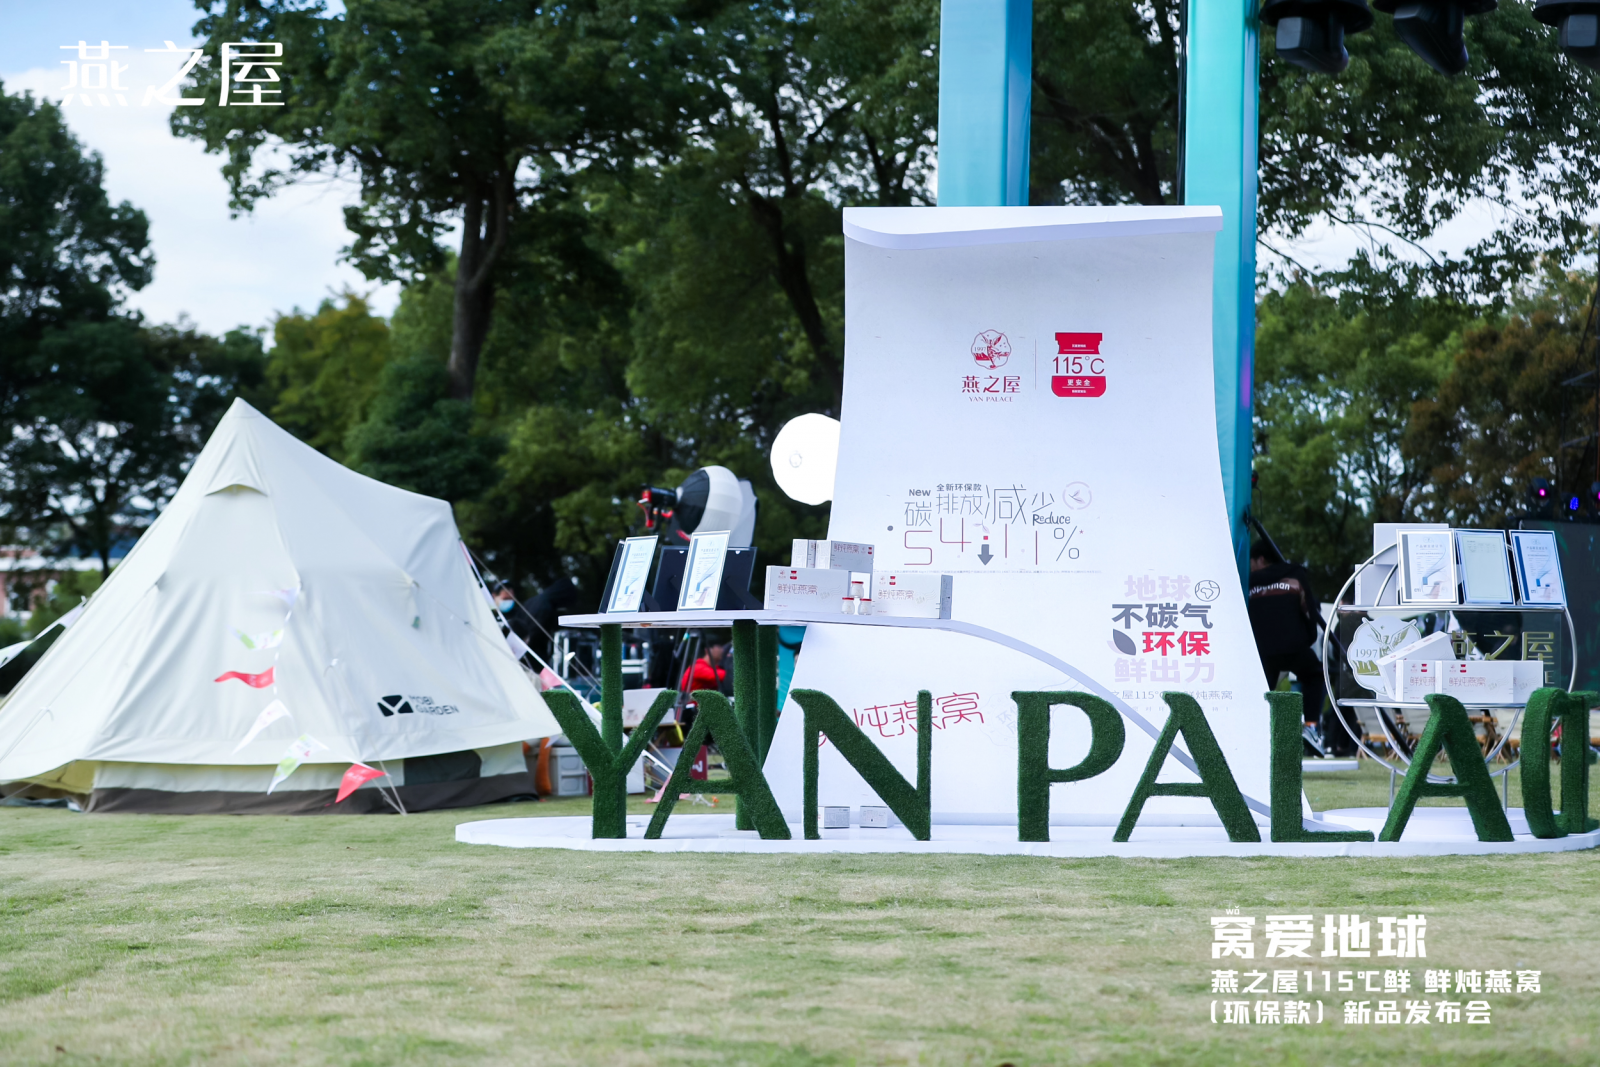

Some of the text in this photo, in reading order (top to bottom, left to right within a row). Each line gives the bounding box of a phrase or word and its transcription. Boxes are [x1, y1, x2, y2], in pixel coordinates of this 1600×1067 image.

[961, 375, 1021, 394] 燕之屋
[1067, 379, 1091, 387] 更安全
[908, 488, 931, 497] New
[936, 483, 982, 492] 全新环保款
[904, 484, 1055, 527] 碳排放减少
[1032, 511, 1071, 526] Reduce
[777, 583, 818, 595] 鲜炖燕窝
[878, 589, 915, 600] 鲜炖燕窝
[1124, 575, 1191, 602] 地球
[1112, 602, 1213, 629] 不碳气
[1142, 631, 1211, 656] 环保
[1447, 630, 1555, 665] 燕之屋
[1355, 648, 1378, 659] 1997
[1114, 658, 1215, 684] 鲜出力
[1410, 676, 1435, 686] 鲜炖燕
[1449, 677, 1486, 687] 鲜炖燕窝
[415, 704, 460, 716] GARDEN
[541, 688, 932, 841] YAN
